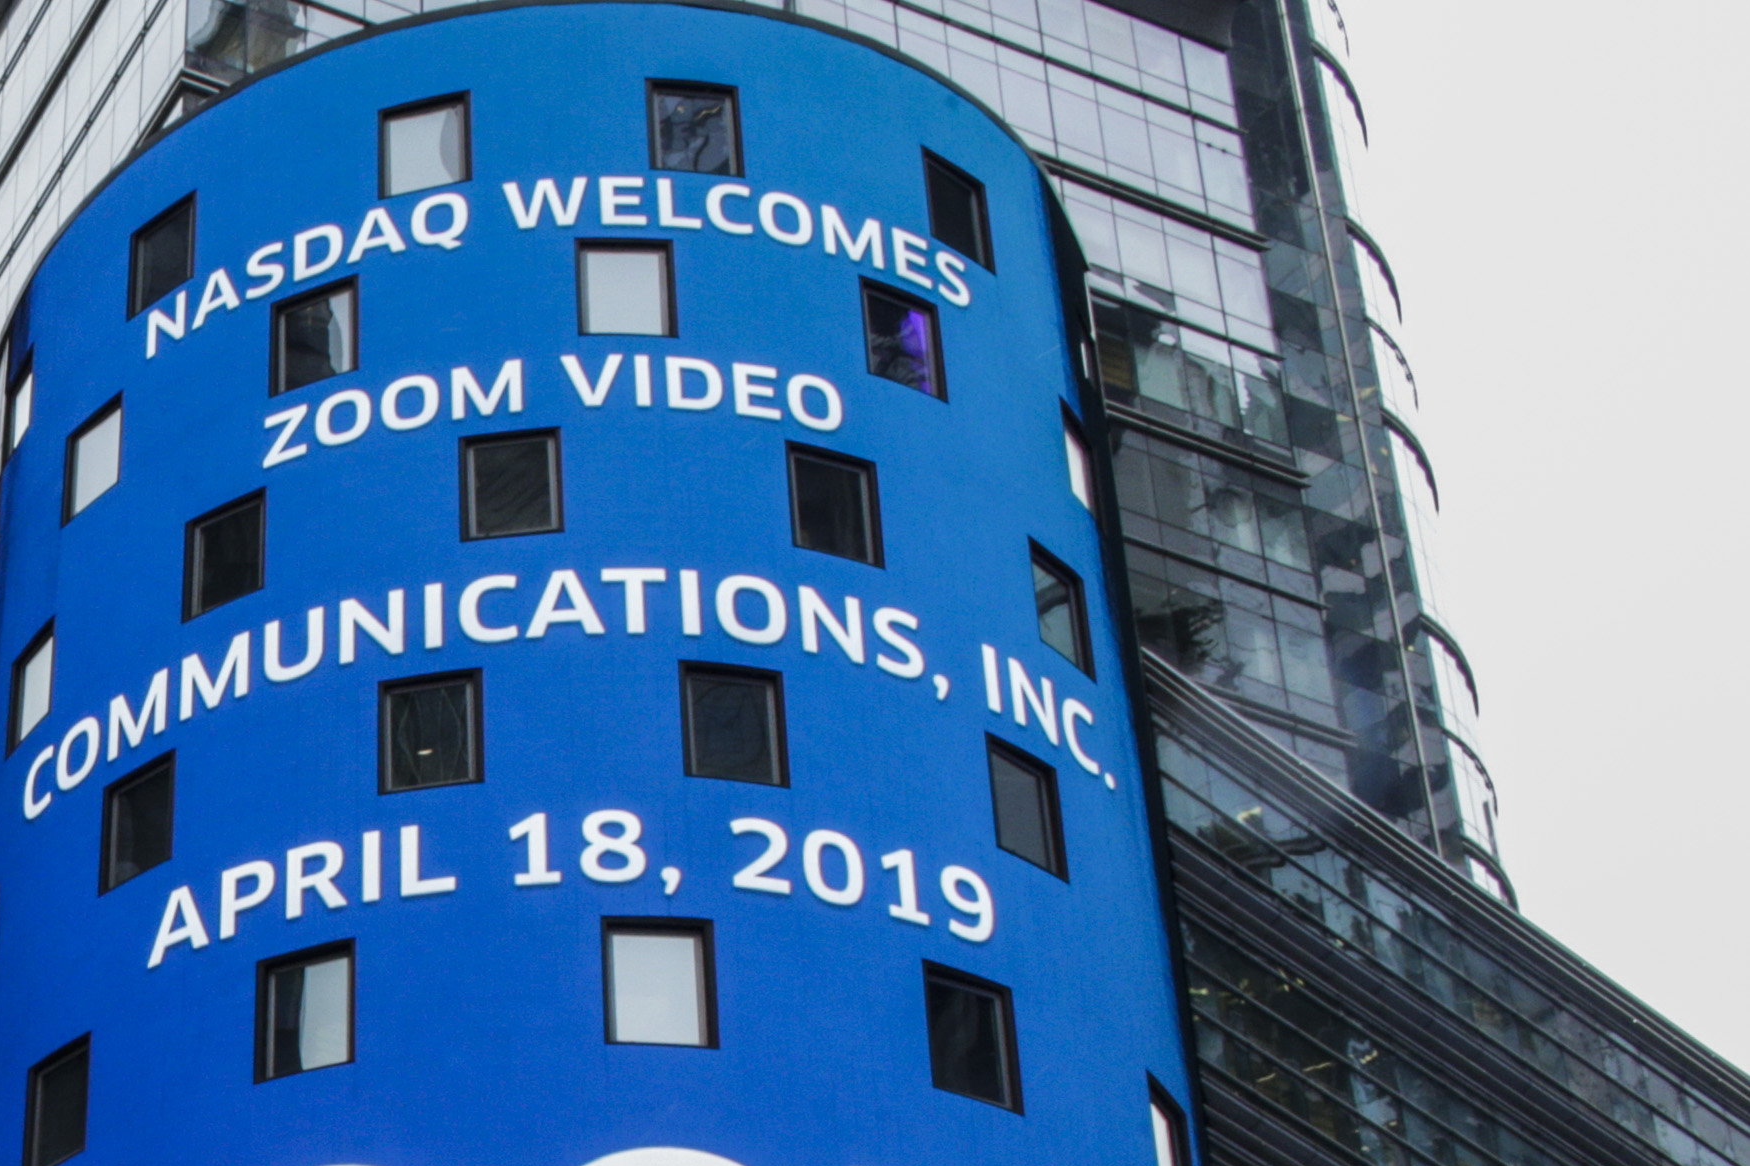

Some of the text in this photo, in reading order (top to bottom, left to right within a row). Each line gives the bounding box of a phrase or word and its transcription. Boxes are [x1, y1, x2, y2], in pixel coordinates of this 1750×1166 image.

[146, 175, 971, 359] NASDAQ WELCOMES
[262, 353, 843, 469] ZOOM VIDEO
[23, 567, 1117, 820] COMMUNICATIONS, INC.
[147, 809, 994, 969] APRIL 18, 2019
